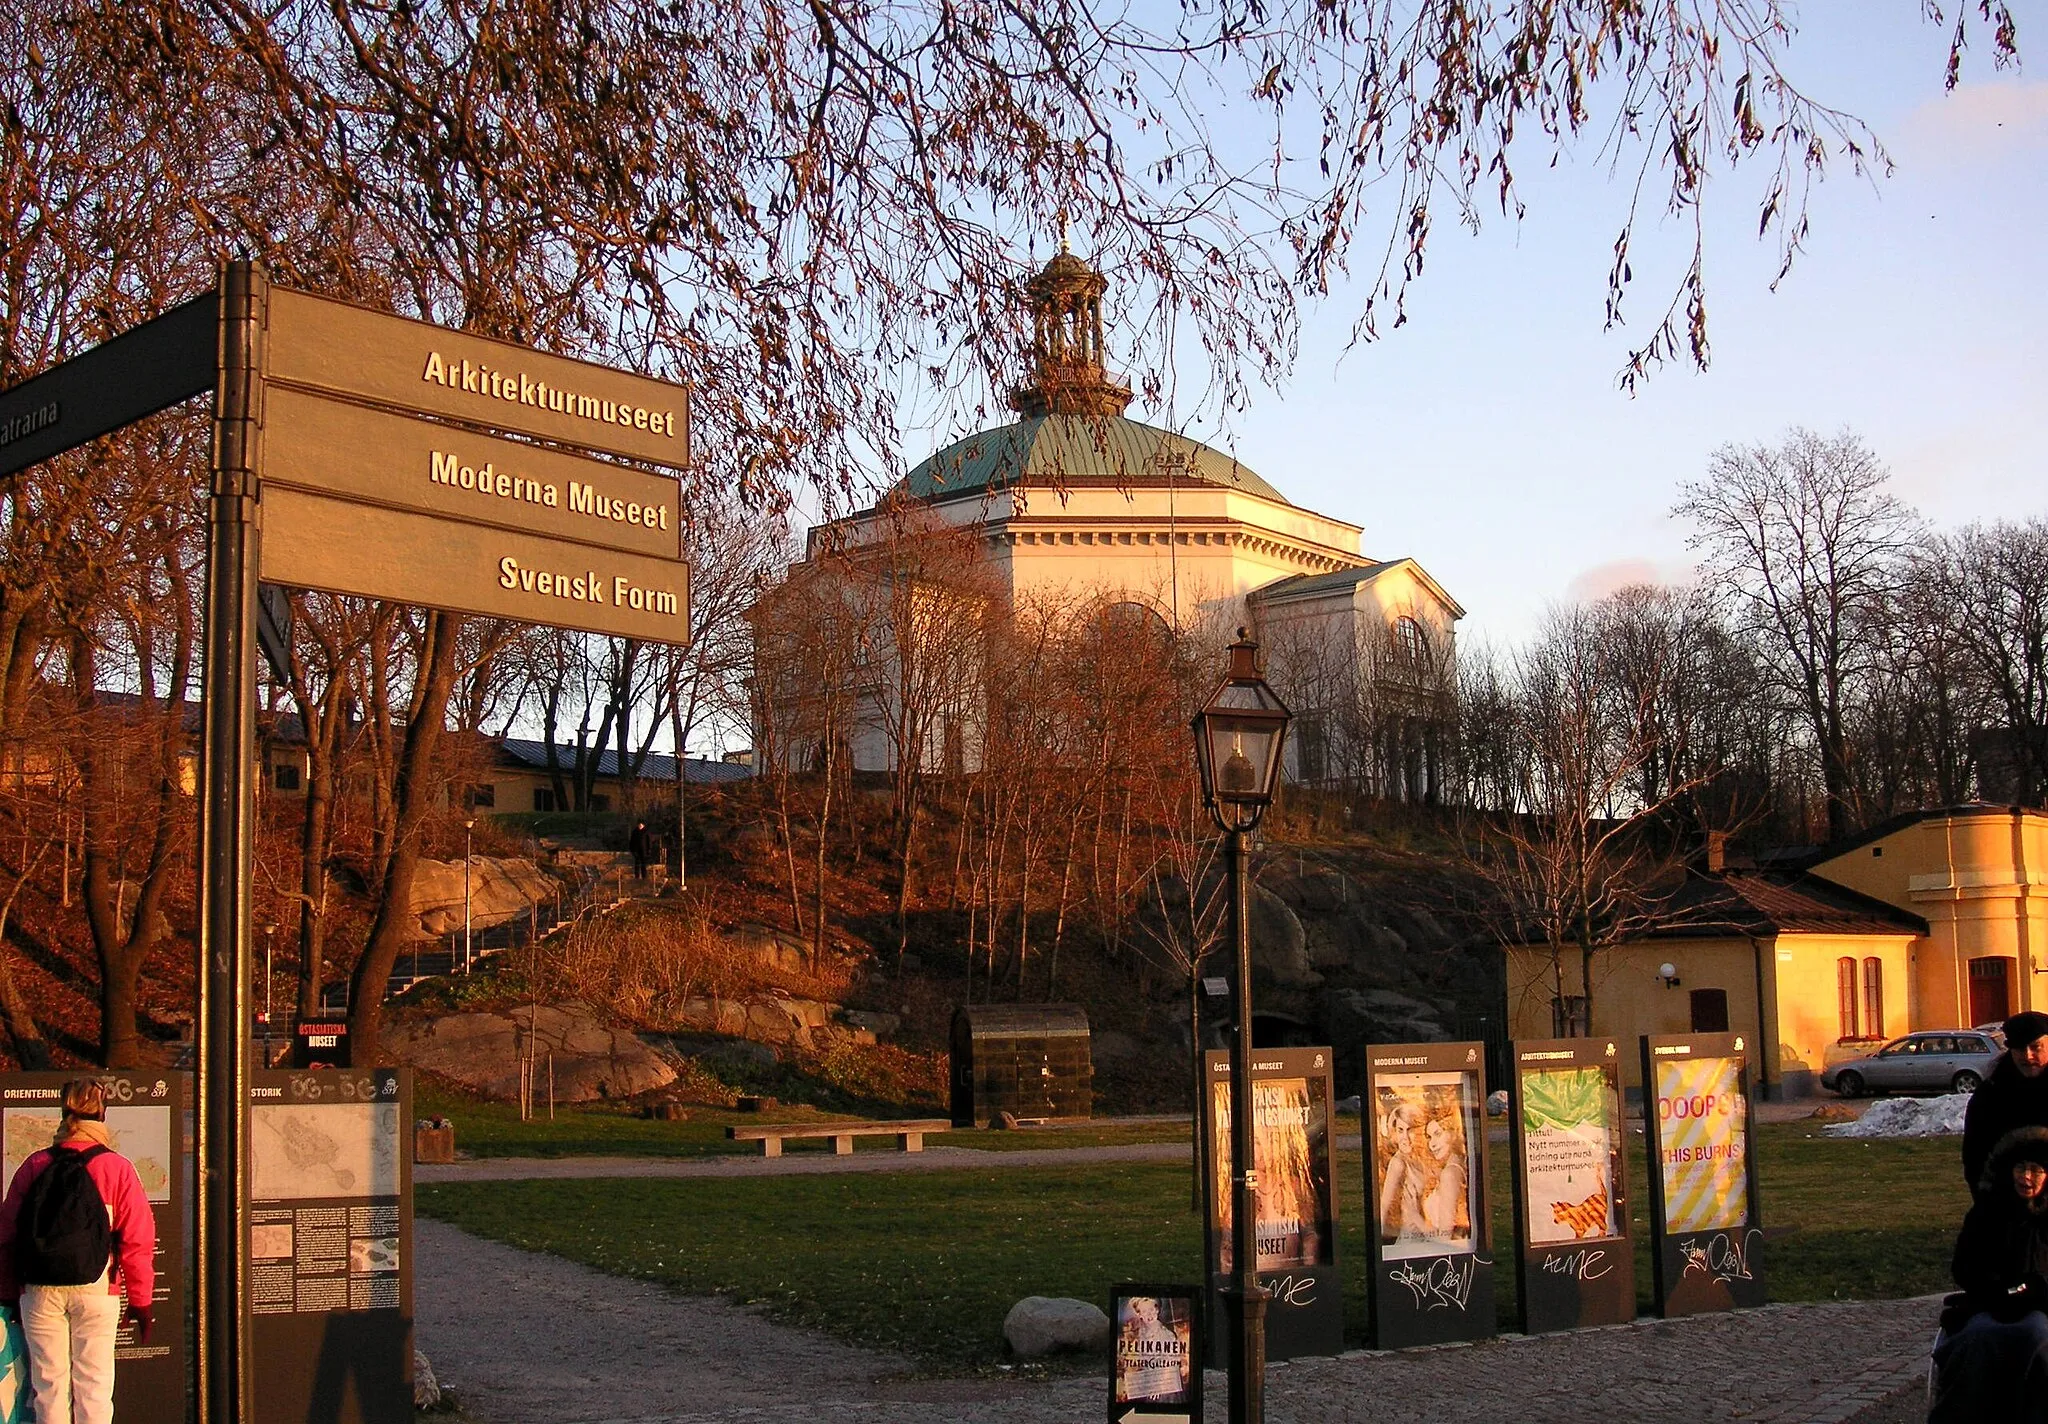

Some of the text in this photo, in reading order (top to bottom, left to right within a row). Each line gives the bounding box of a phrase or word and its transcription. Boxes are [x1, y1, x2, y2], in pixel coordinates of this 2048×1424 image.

[423, 351, 675, 438] Arkitekturmuseet
[0, 401, 57, 445] atrarna
[430, 450, 668, 531] Moderna Museet
[499, 556, 678, 615] Svensk Form
[308, 1036, 338, 1047] MUSEET
[1259, 1062, 1283, 1070] MUSEET
[1374, 1057, 1428, 1066] MODERNA MUSEET
[250, 1088, 282, 1097] STORIK
[1528, 1141, 1547, 1151] Nytt
[1529, 1153, 1558, 1162] tidning
[1257, 1238, 1286, 1256] USEET
[1119, 1341, 1187, 1354] PELIKANEN
